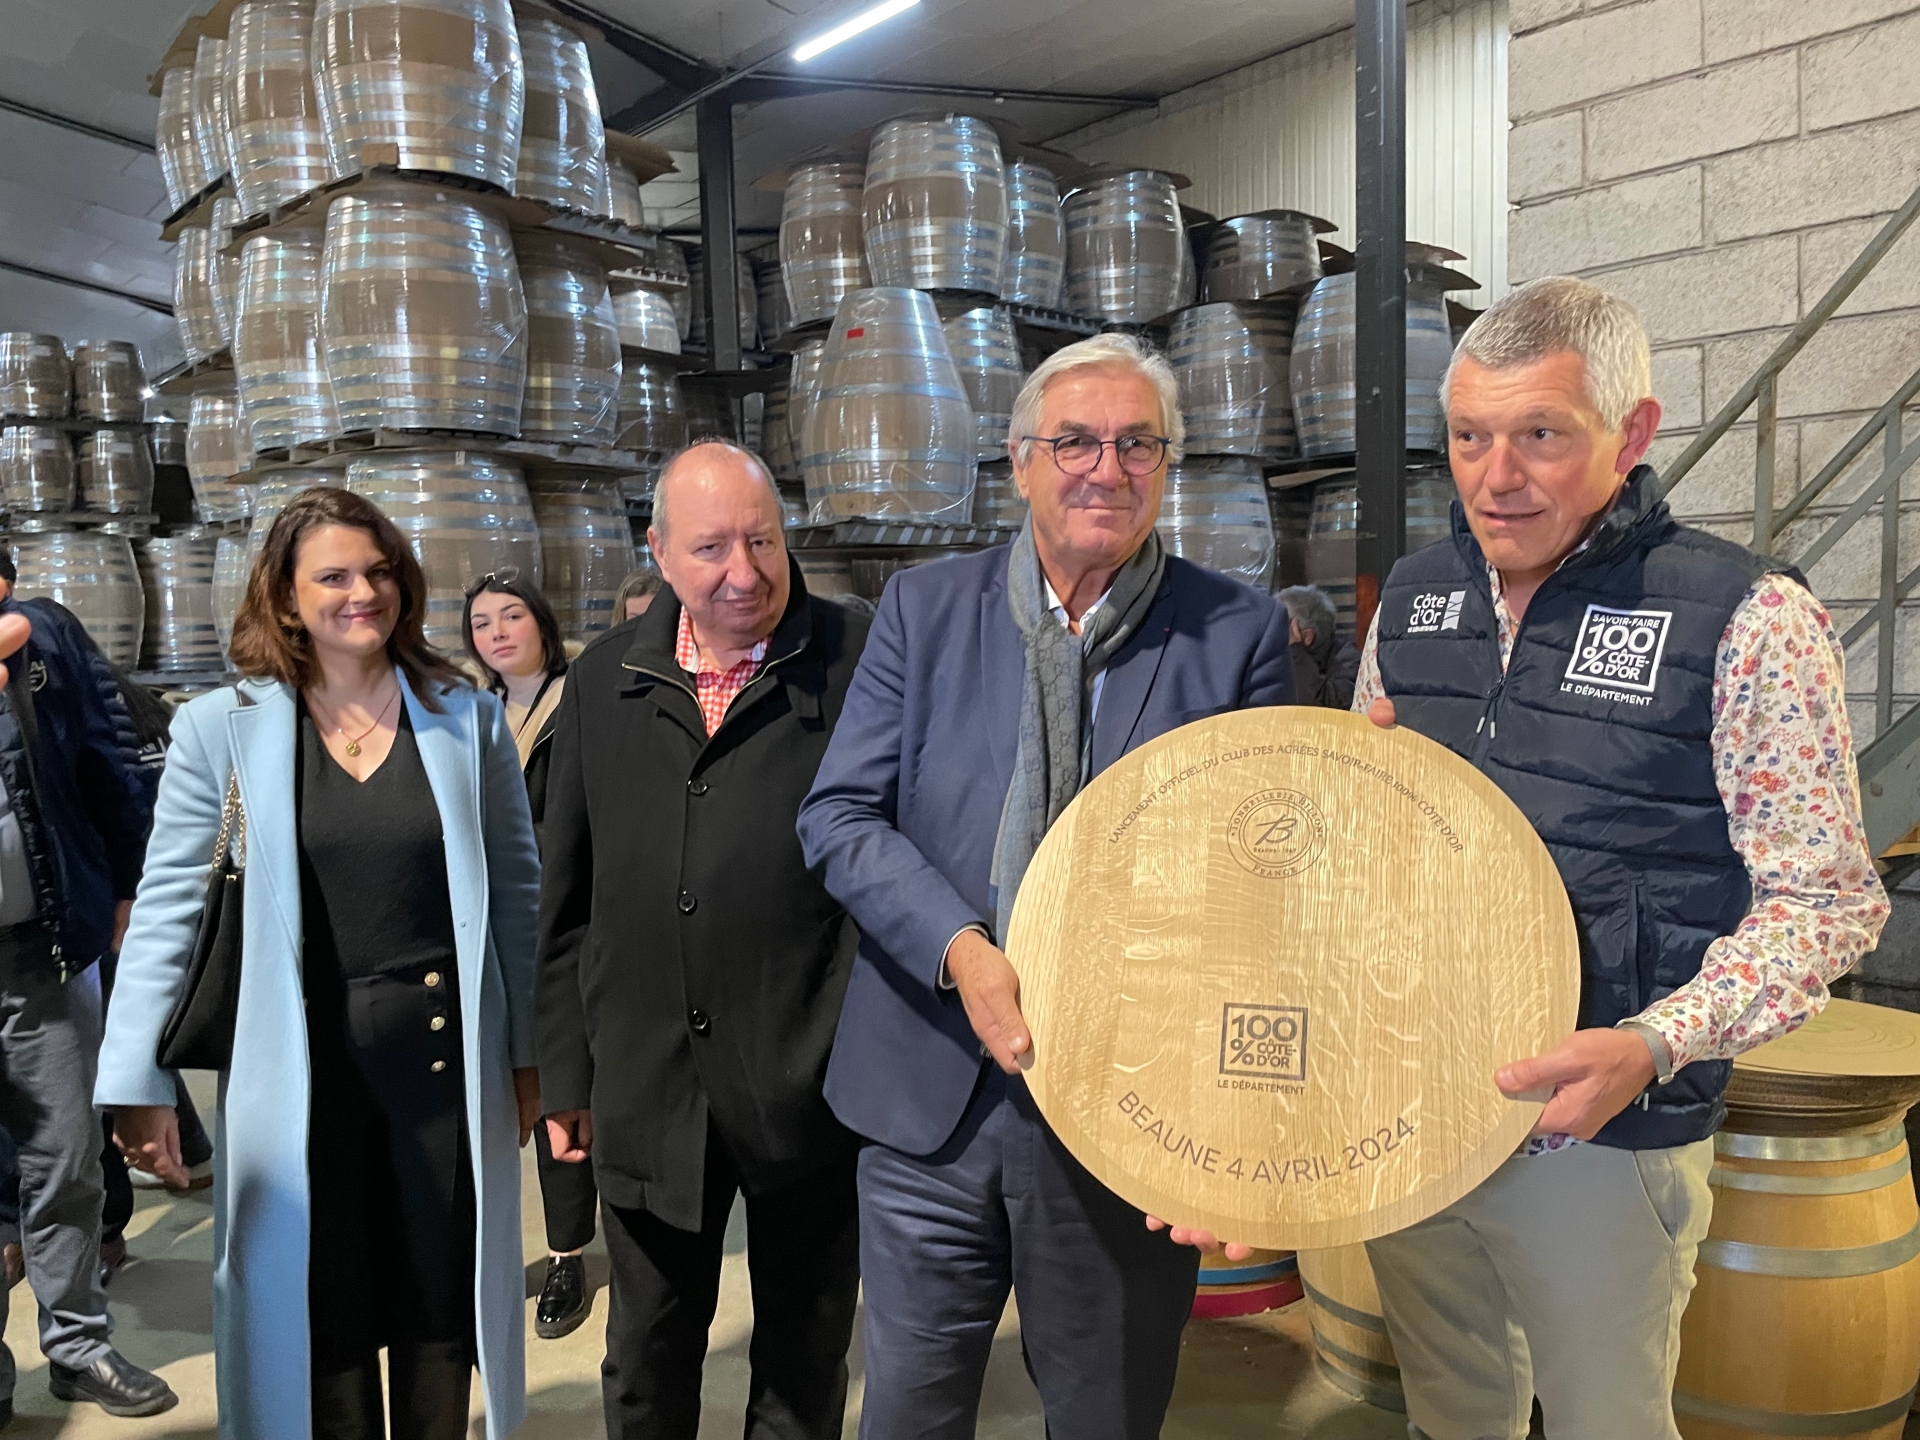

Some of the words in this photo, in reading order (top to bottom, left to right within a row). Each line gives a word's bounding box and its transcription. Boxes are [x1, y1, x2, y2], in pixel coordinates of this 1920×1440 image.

[1414, 593, 1446, 609] Côte
[1410, 608, 1441, 625] d'Or
[1593, 614, 1660, 628] SAVOIR-FAIRE
[1588, 623, 1655, 653] 100
[1608, 648, 1649, 668] CÔTE-
[1604, 664, 1640, 680] D'OR
[1560, 682, 1573, 692] LE
[1575, 684, 1653, 706] DÉPARTEMENT
[1108, 791, 1158, 844] LANCEMENT
[1158, 765, 1202, 794] OFFICIEL
[1201, 756, 1220, 770] DU
[1221, 748, 1250, 763] CLUB
[1252, 745, 1274, 756] DES
[1276, 743, 1319, 757] AGRÉES
[1321, 749, 1394, 785] SAVOIR-FAIRE
[1392, 781, 1418, 803] 100%
[1441, 825, 1463, 853] D'OR
[1252, 864, 1298, 877] FRANCE
[1231, 1014, 1298, 1042] 100
[1257, 1038, 1297, 1056] CÔTE-
[1256, 1053, 1290, 1069] D'OR
[1217, 1079, 1229, 1088] LE
[1232, 1079, 1305, 1096] DÉPARTEMENT
[1117, 1090, 1221, 1174] BEAUNE
[1226, 1157, 1244, 1180] 4
[1251, 1154, 1341, 1184] AVRIL
[1342, 1116, 1415, 1170] 2024
